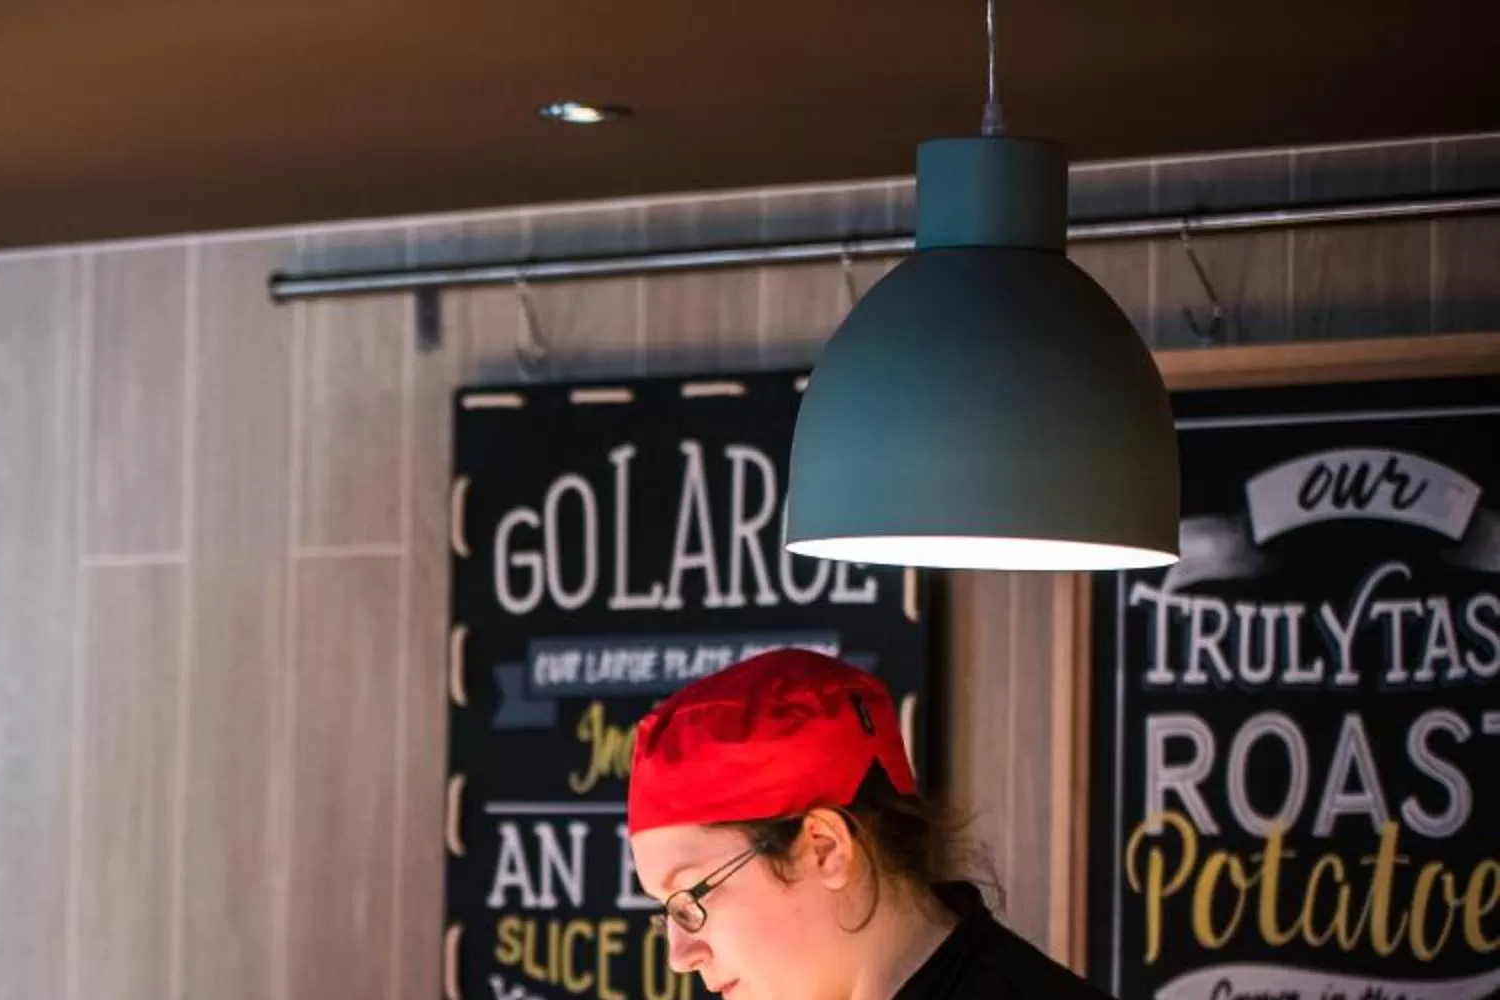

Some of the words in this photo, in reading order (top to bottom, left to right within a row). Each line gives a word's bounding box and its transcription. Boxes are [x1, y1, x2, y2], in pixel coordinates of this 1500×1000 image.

[495, 474, 598, 614] GO
[1298, 456, 1428, 511] our
[1130, 563, 1411, 685] TRULY
[1145, 709, 1500, 838] ROAS
[486, 822, 589, 909] AN
